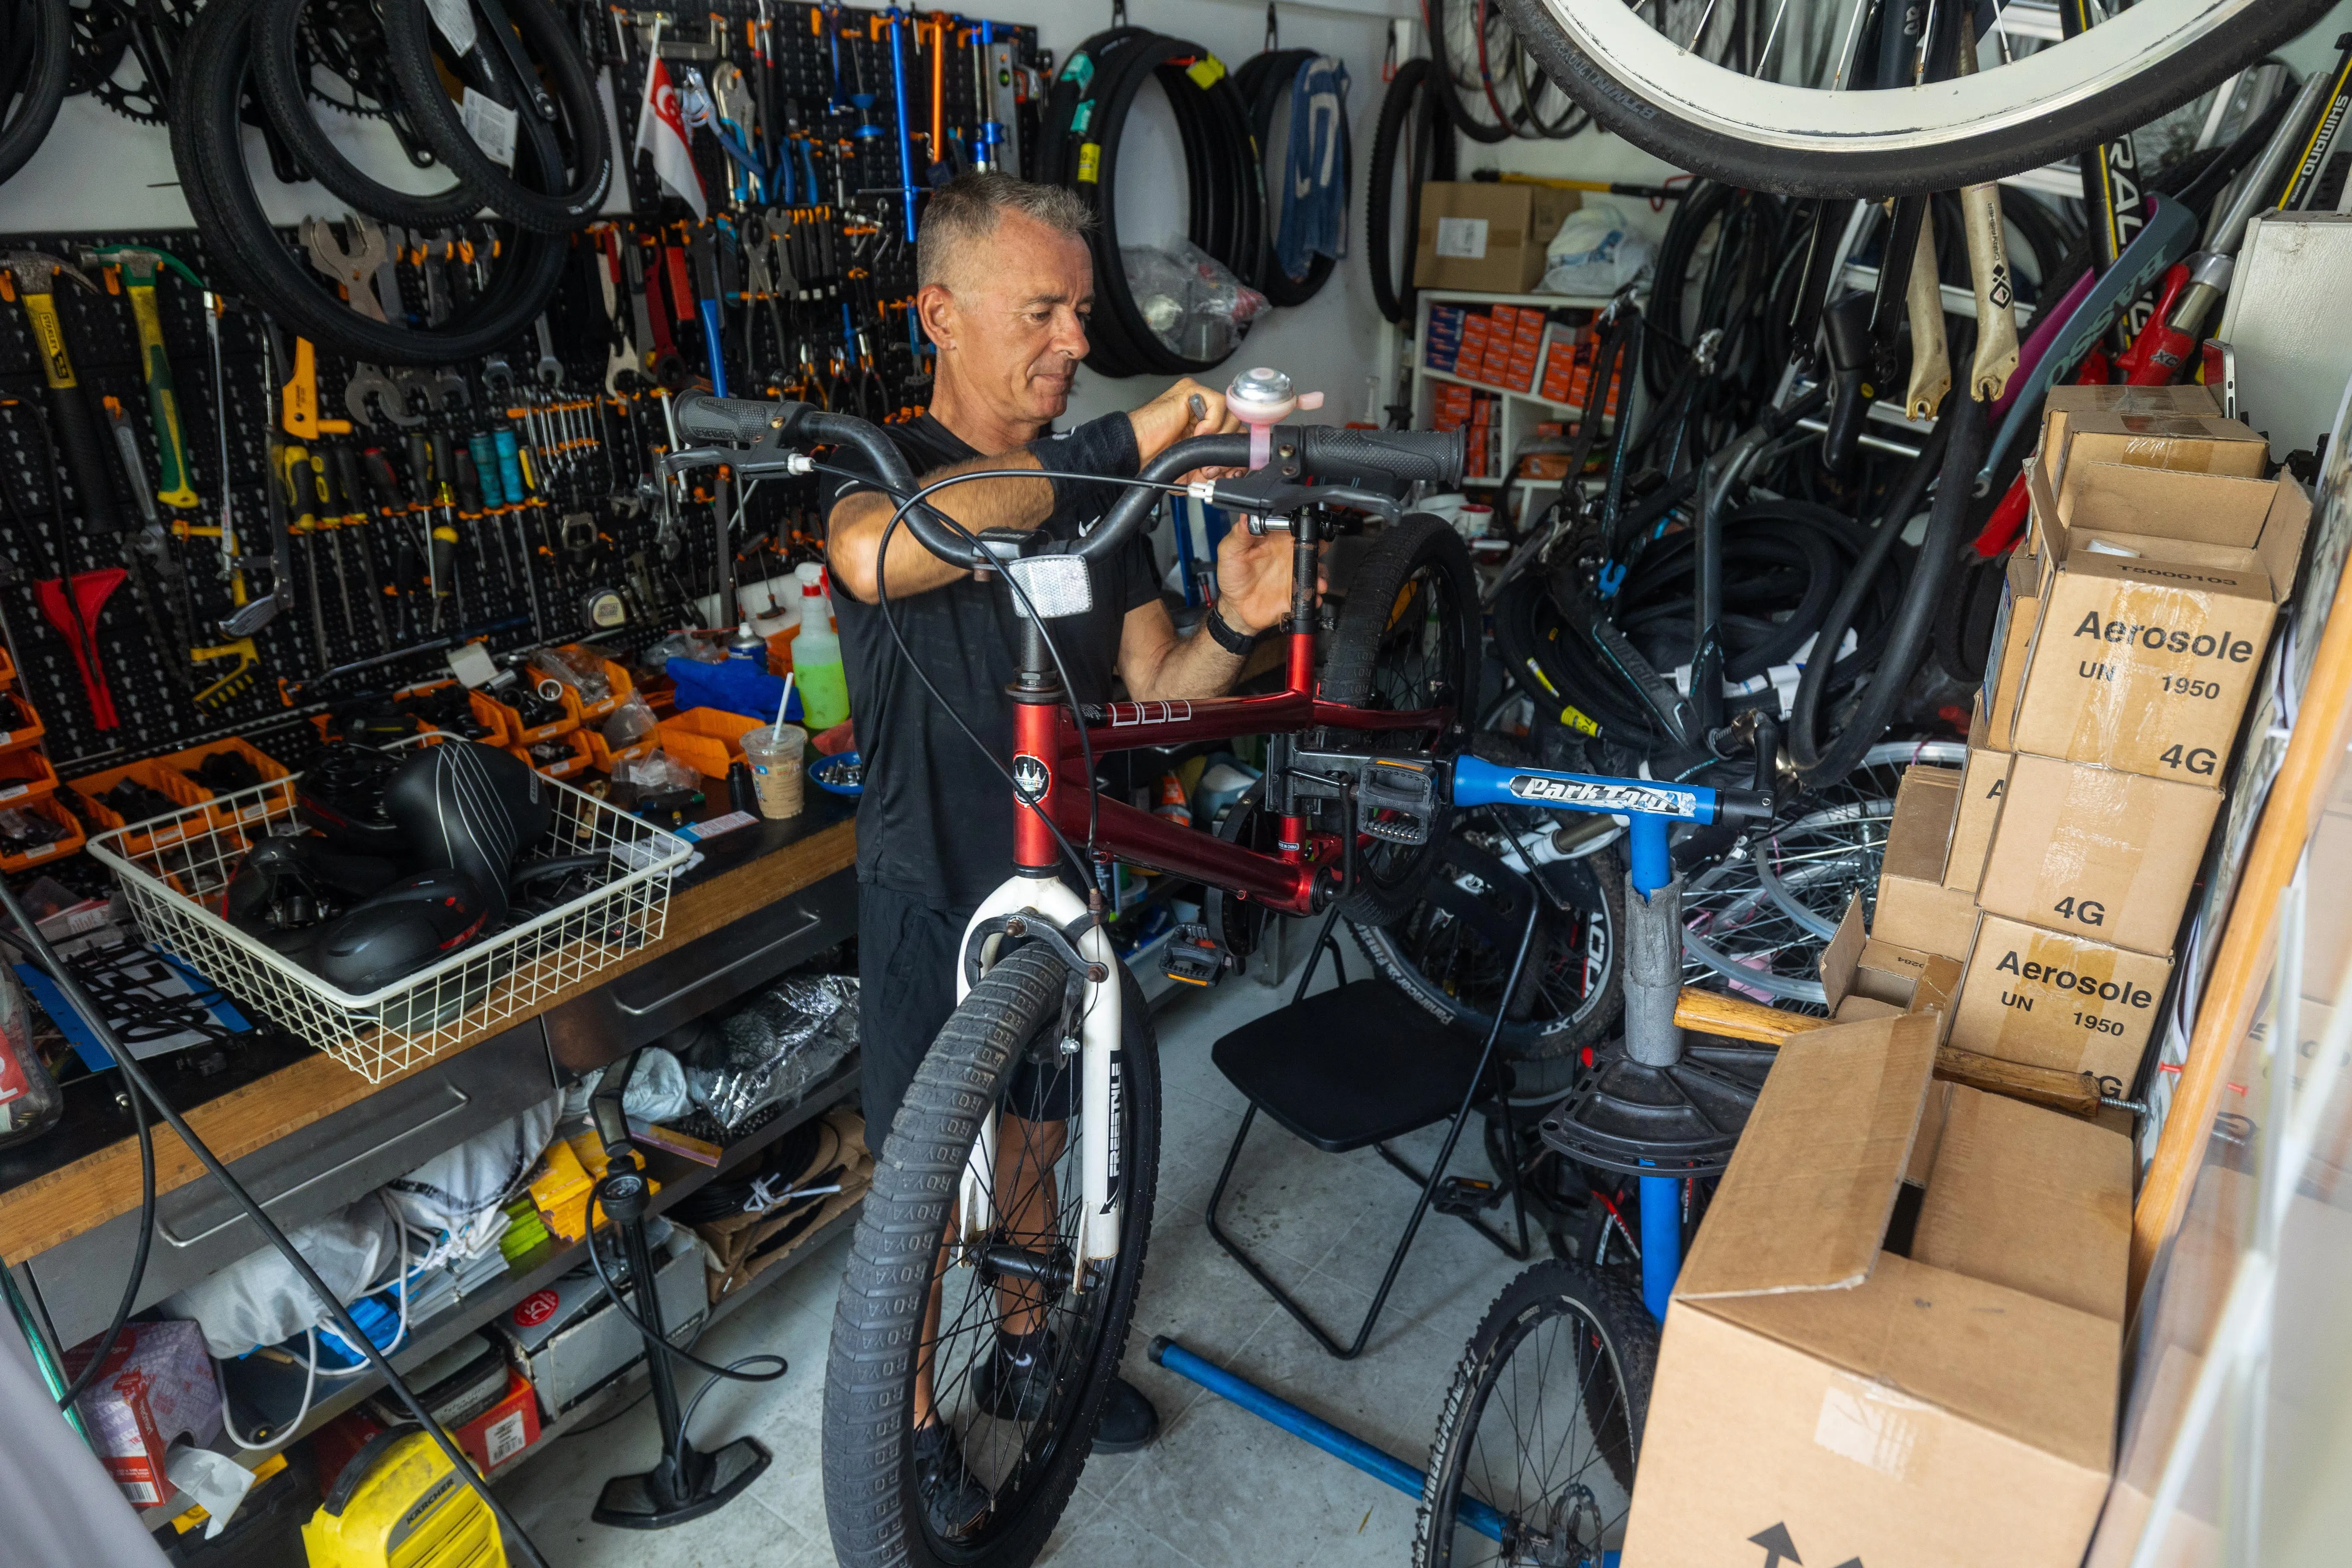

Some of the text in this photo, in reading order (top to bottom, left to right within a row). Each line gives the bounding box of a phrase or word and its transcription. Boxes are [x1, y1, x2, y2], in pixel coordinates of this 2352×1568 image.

[2301, 95, 2350, 177] SHIMANO
[1988, 202, 2002, 260] GARY FISHER
[2045, 245, 2167, 393] BASSO
[2150, 349, 2180, 367] XC
[2117, 565, 2237, 586] T5000103
[2074, 611, 2253, 663] Aerosole
[2079, 661, 2220, 699] UN 1950
[2160, 745, 2217, 775] 4G
[2054, 897, 2105, 925] 4G
[1395, 974, 1454, 1024] Panaracer
[1996, 951, 2152, 1009] Aerosole
[2001, 991, 2125, 1037] UN 1950
